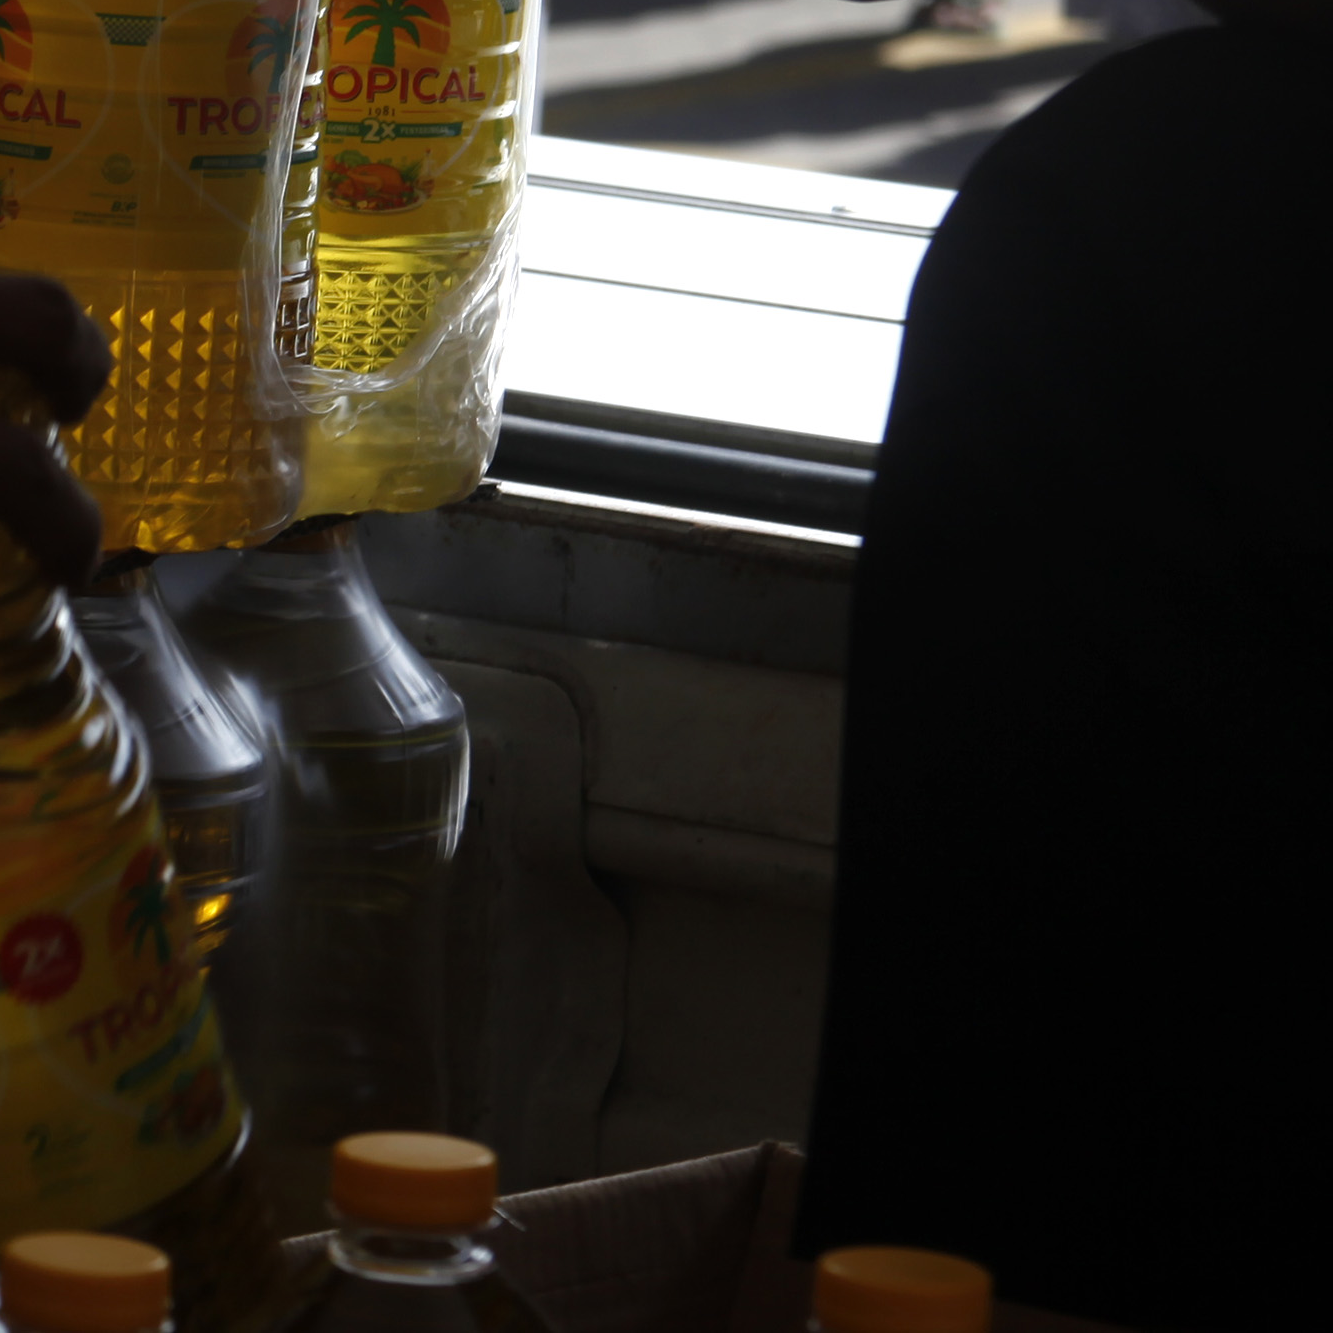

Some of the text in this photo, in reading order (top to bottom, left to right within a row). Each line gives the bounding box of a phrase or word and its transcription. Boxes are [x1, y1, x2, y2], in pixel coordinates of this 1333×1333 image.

[327, 64, 486, 104] OPICAL
[368, 105, 396, 118] 1981
[363, 118, 396, 143] 2x
[11, 933, 66, 980] 2x
